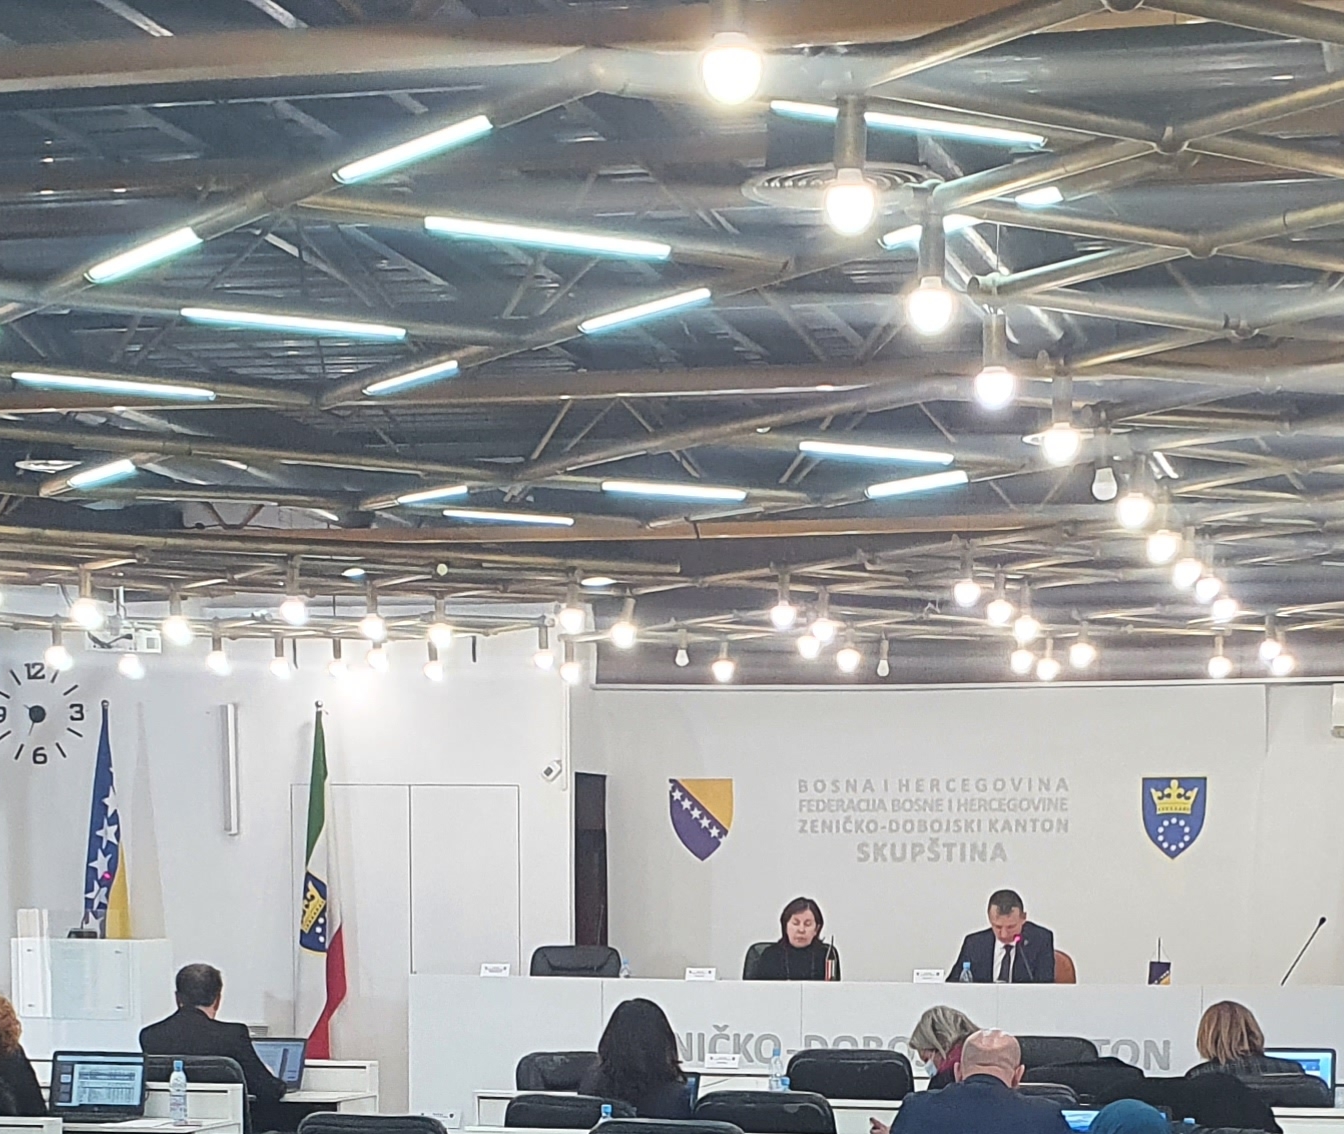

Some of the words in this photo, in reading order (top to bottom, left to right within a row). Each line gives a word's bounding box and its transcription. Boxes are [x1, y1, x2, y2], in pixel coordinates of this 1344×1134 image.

[24, 662, 46, 680] 12
[69, 703, 85, 721] 3
[32, 747, 48, 765] 6
[798, 778, 875, 793] BOSNA
[883, 778, 888, 793] I
[898, 777, 1069, 793] HERCEGOVINA
[799, 799, 887, 813] FEDERACIJA
[891, 798, 943, 812] BOSNE
[948, 798, 953, 812] I
[957, 797, 1069, 812] HERCEGOVINE
[798, 815, 982, 834] ZENIČKO-DOBOJSKI
[988, 818, 1069, 833] KANTON
[856, 837, 1008, 862] SKUPŠTINA
